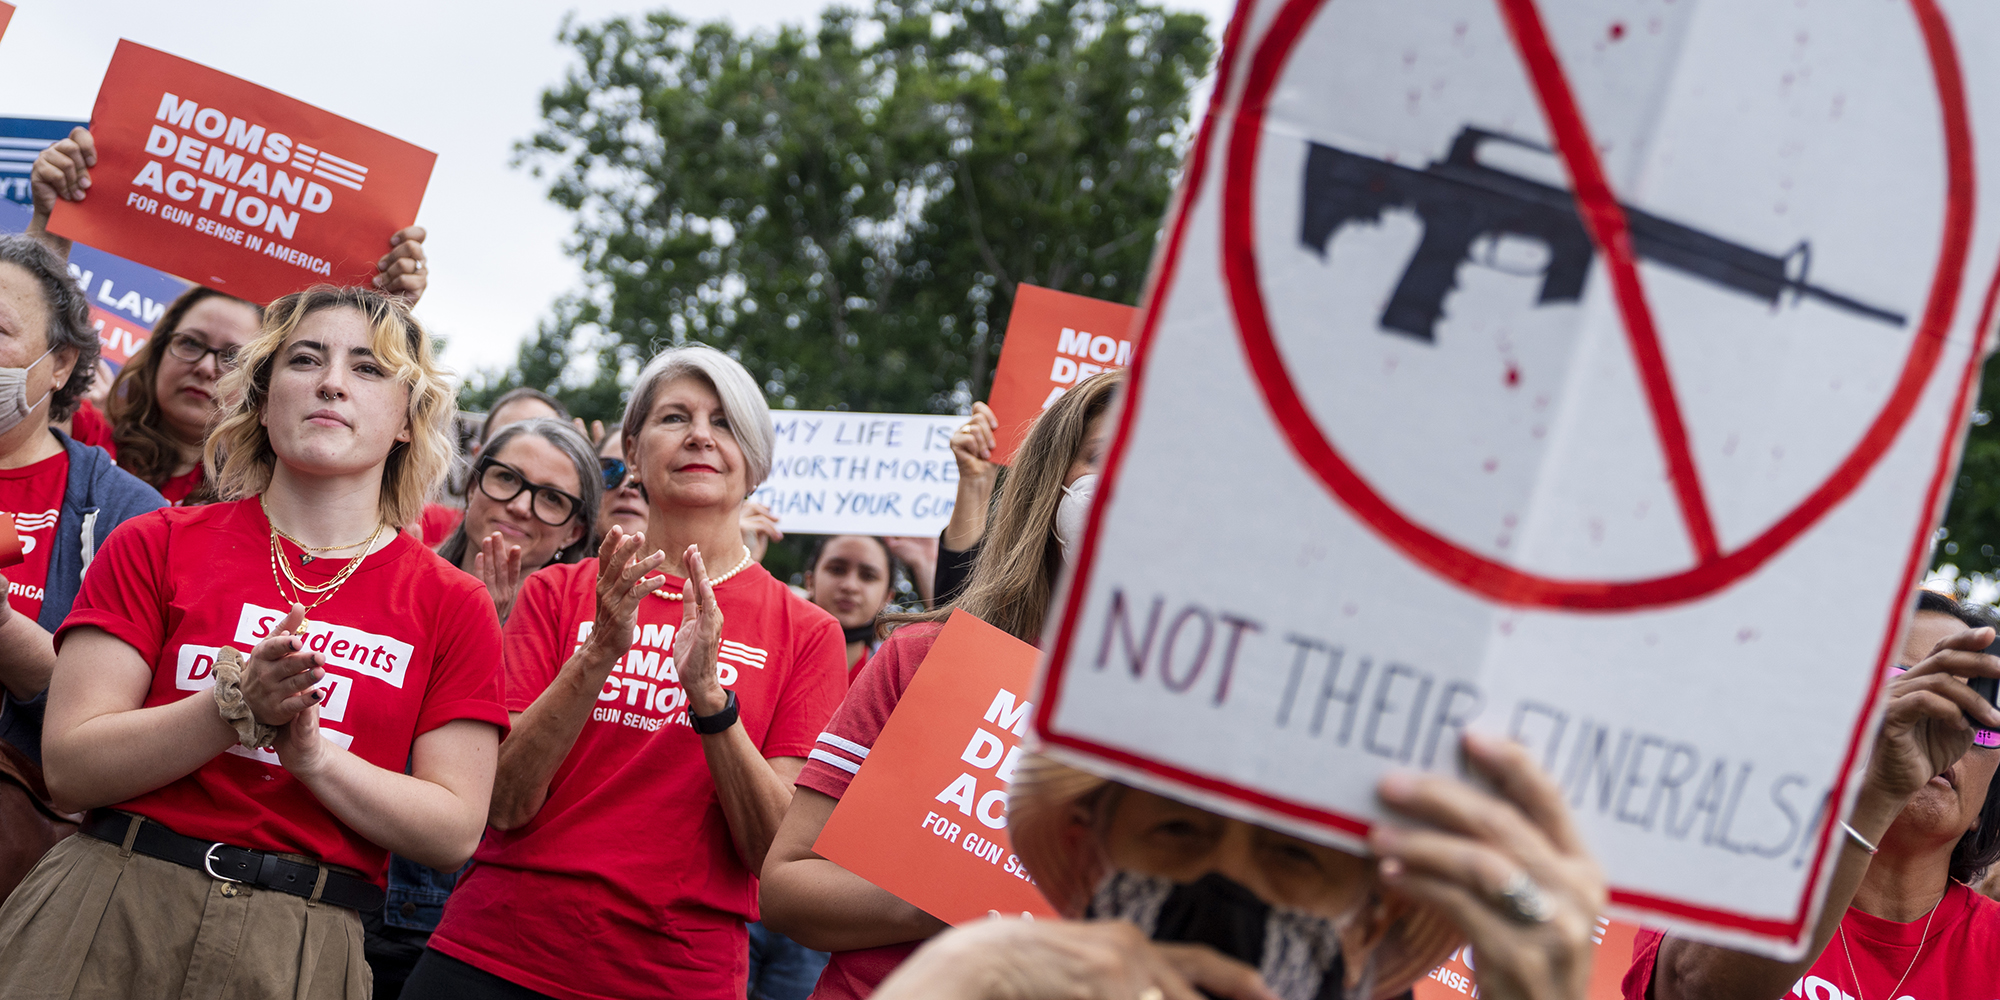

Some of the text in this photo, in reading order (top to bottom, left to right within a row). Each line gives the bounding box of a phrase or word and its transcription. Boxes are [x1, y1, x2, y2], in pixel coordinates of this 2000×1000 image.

[155, 92, 293, 164] MOMS
[132, 160, 300, 240] ACTION
[144, 124, 333, 214] DEMAND
[126, 192, 332, 277] FOR GUN SENSE IN AMERICA
[775, 418, 954, 452] MY LIFE IS
[770, 455, 960, 483] WORTH MORE
[754, 485, 826, 514] THAN
[834, 490, 903, 518] YOUR
[1093, 583, 1266, 708] NOT
[1273, 630, 1487, 771] THEIR
[592, 707, 621, 723] GUN
[622, 712, 665, 732] SENSE
[921, 811, 962, 843] FOR
[962, 832, 1004, 865] GUN
